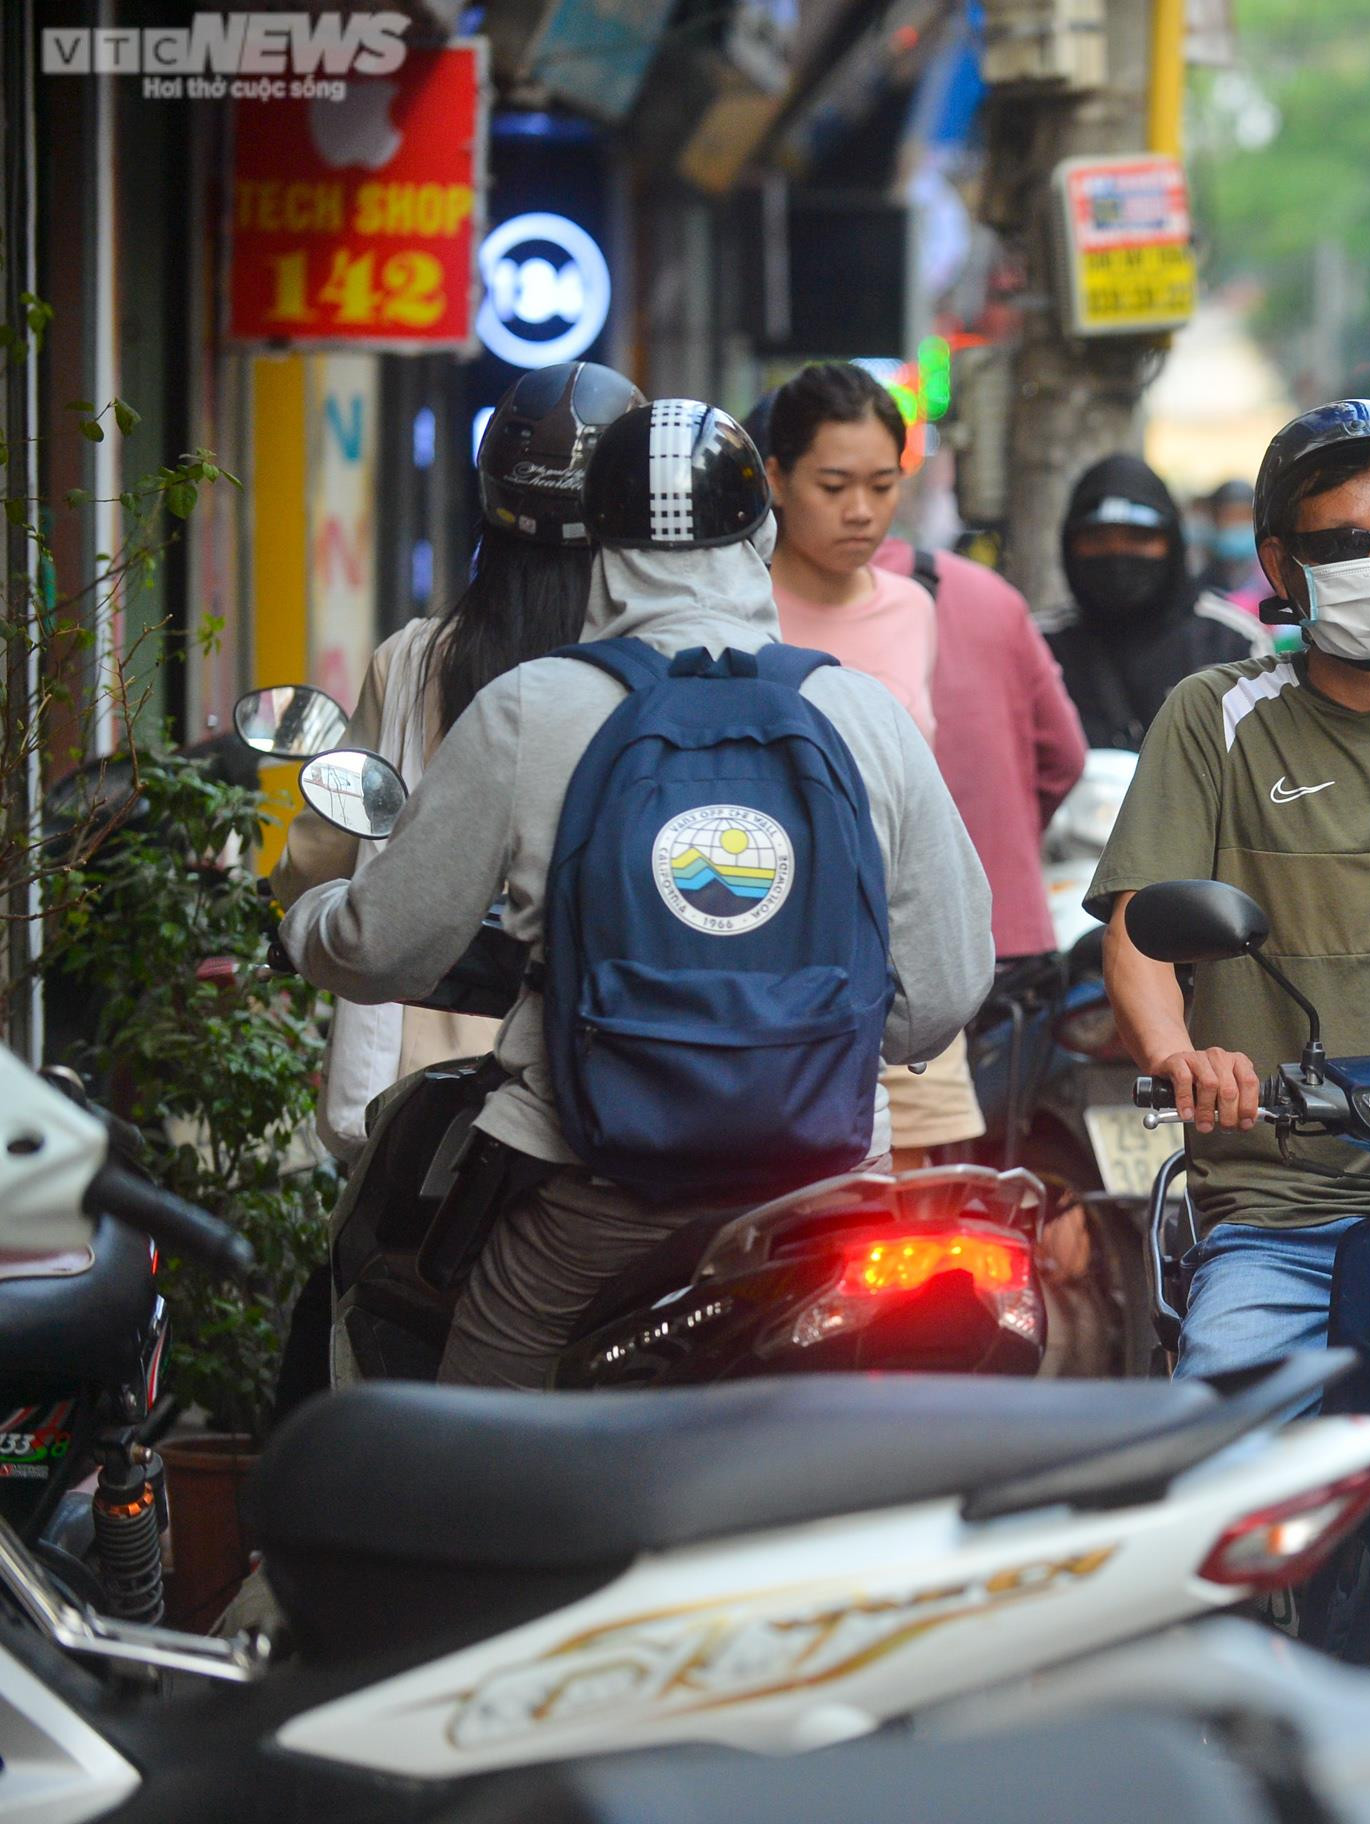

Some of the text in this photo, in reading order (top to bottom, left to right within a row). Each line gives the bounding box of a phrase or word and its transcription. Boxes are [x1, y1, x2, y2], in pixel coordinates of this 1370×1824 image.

[236, 182, 474, 235] TECH SHOP
[266, 249, 447, 327] 142
[670, 809, 778, 838] VANS OFF THE WALL
[657, 847, 687, 914] CALIFORNIA
[752, 855, 788, 920] WORLDWIDE
[703, 917, 734, 929] 1966
